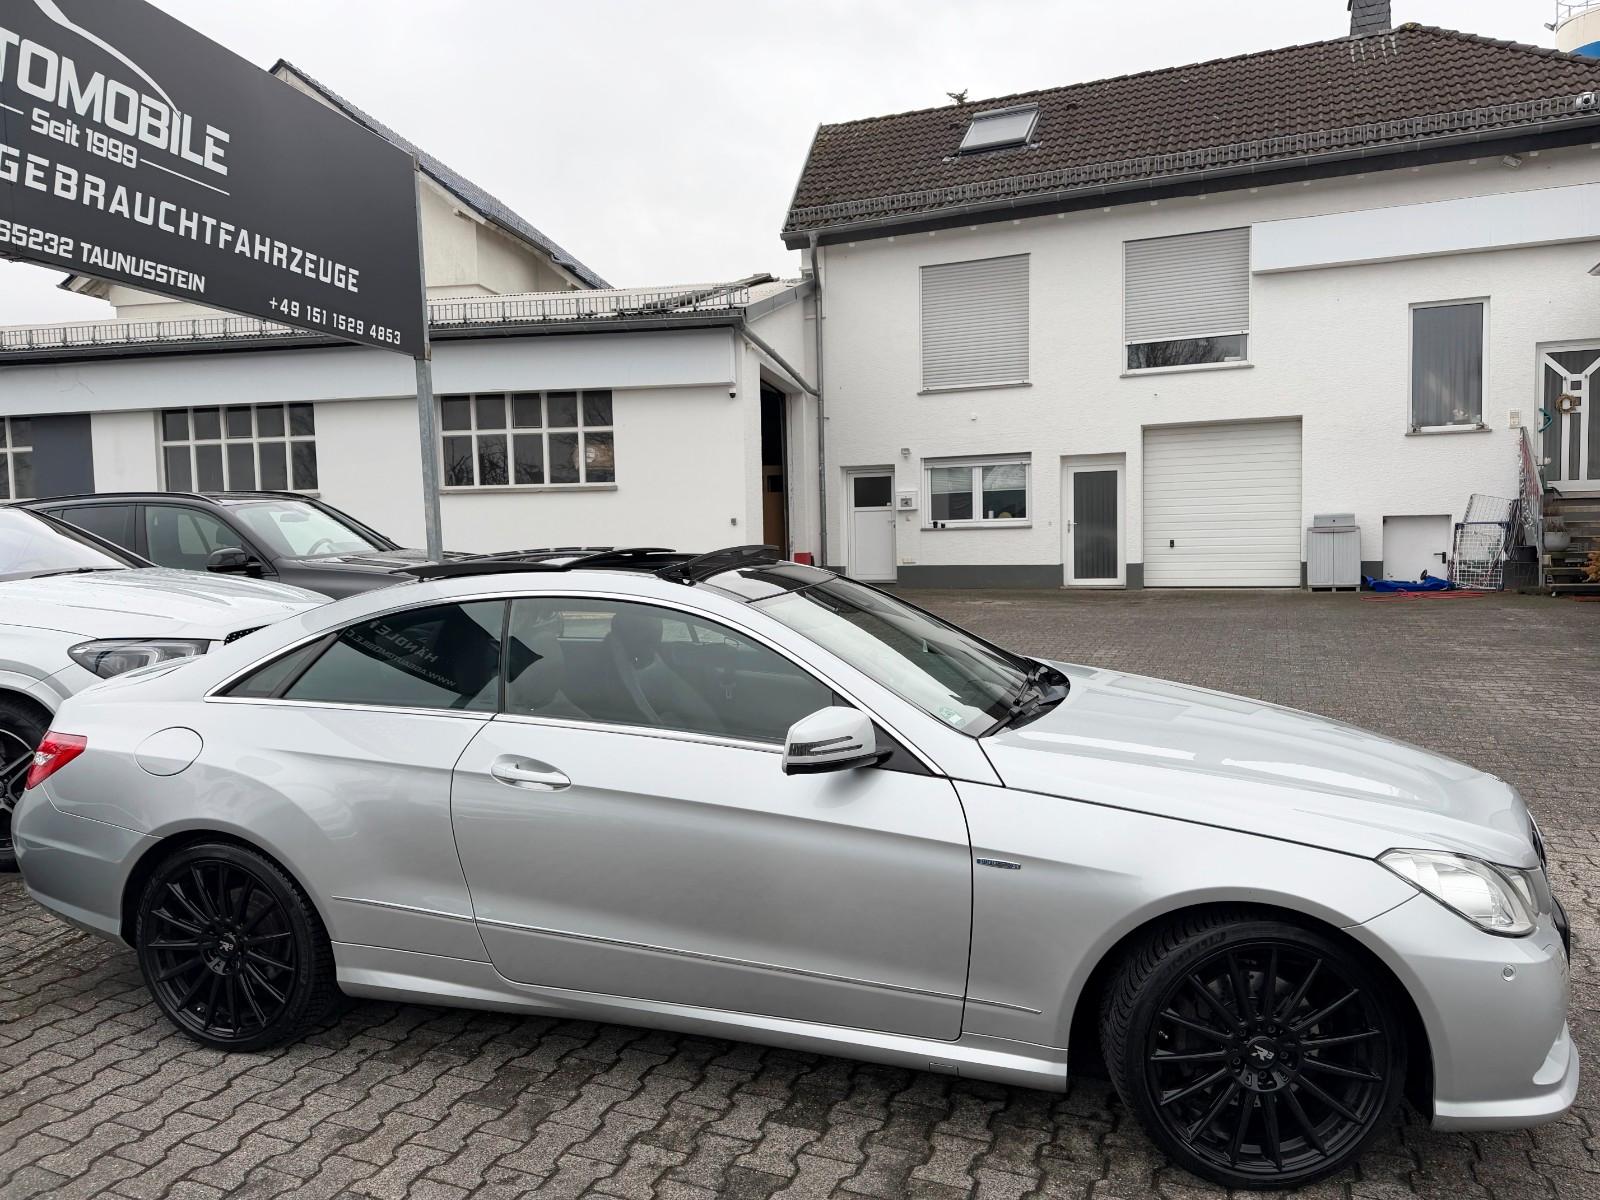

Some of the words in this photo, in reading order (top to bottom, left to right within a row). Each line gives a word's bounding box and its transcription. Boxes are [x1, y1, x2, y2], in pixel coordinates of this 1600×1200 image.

[0, 26, 230, 176] TOMOBILE
[31, 107, 81, 148] Seit
[85, 128, 138, 169] 1999
[0, 143, 360, 293] GEBRAUCHTFAHRZEUGE
[0, 219, 74, 259] 65232
[80, 241, 206, 293] TAUNUSSTEIN
[269, 297, 300, 318] +49
[306, 305, 327, 325] 151
[332, 312, 364, 335] 1529
[369, 324, 401, 344] 4853
